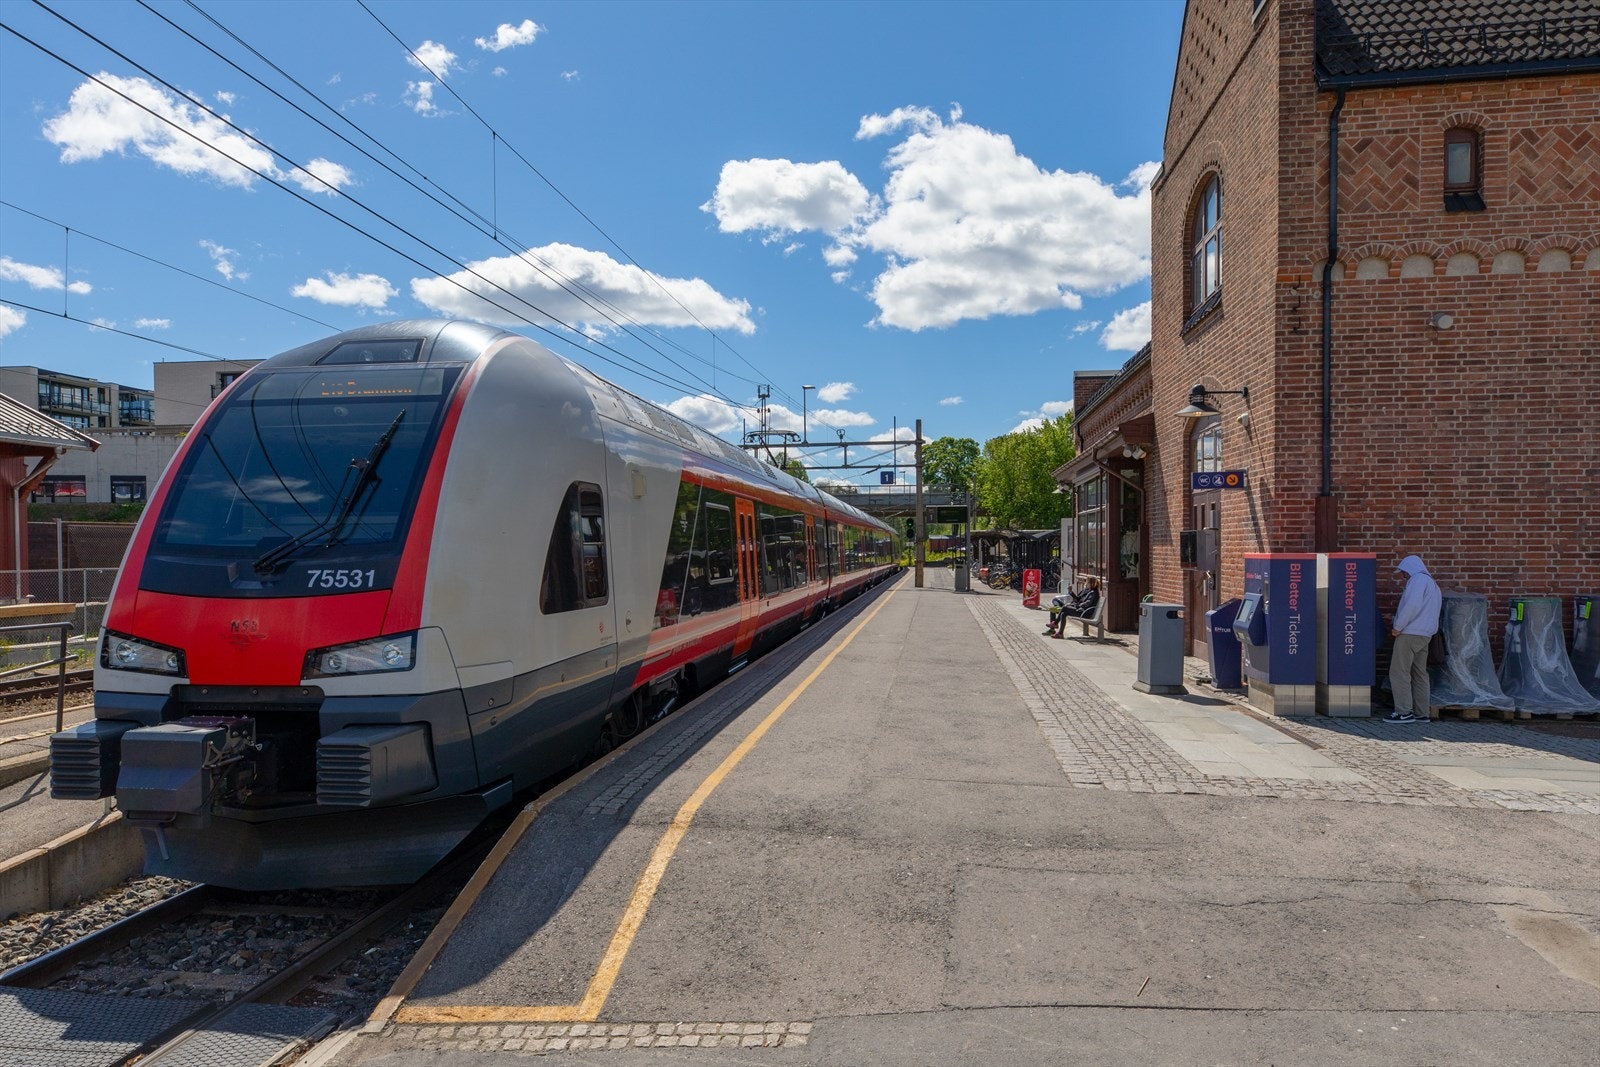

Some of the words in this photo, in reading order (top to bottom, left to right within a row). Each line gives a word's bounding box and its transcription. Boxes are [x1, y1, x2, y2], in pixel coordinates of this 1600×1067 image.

[884, 474, 889, 482] 1
[307, 569, 376, 588] 75531
[1289, 563, 1302, 611] Billetter
[1345, 562, 1357, 611] Billetter
[1289, 614, 1301, 655] Tickets
[1345, 613, 1357, 655] Tickets
